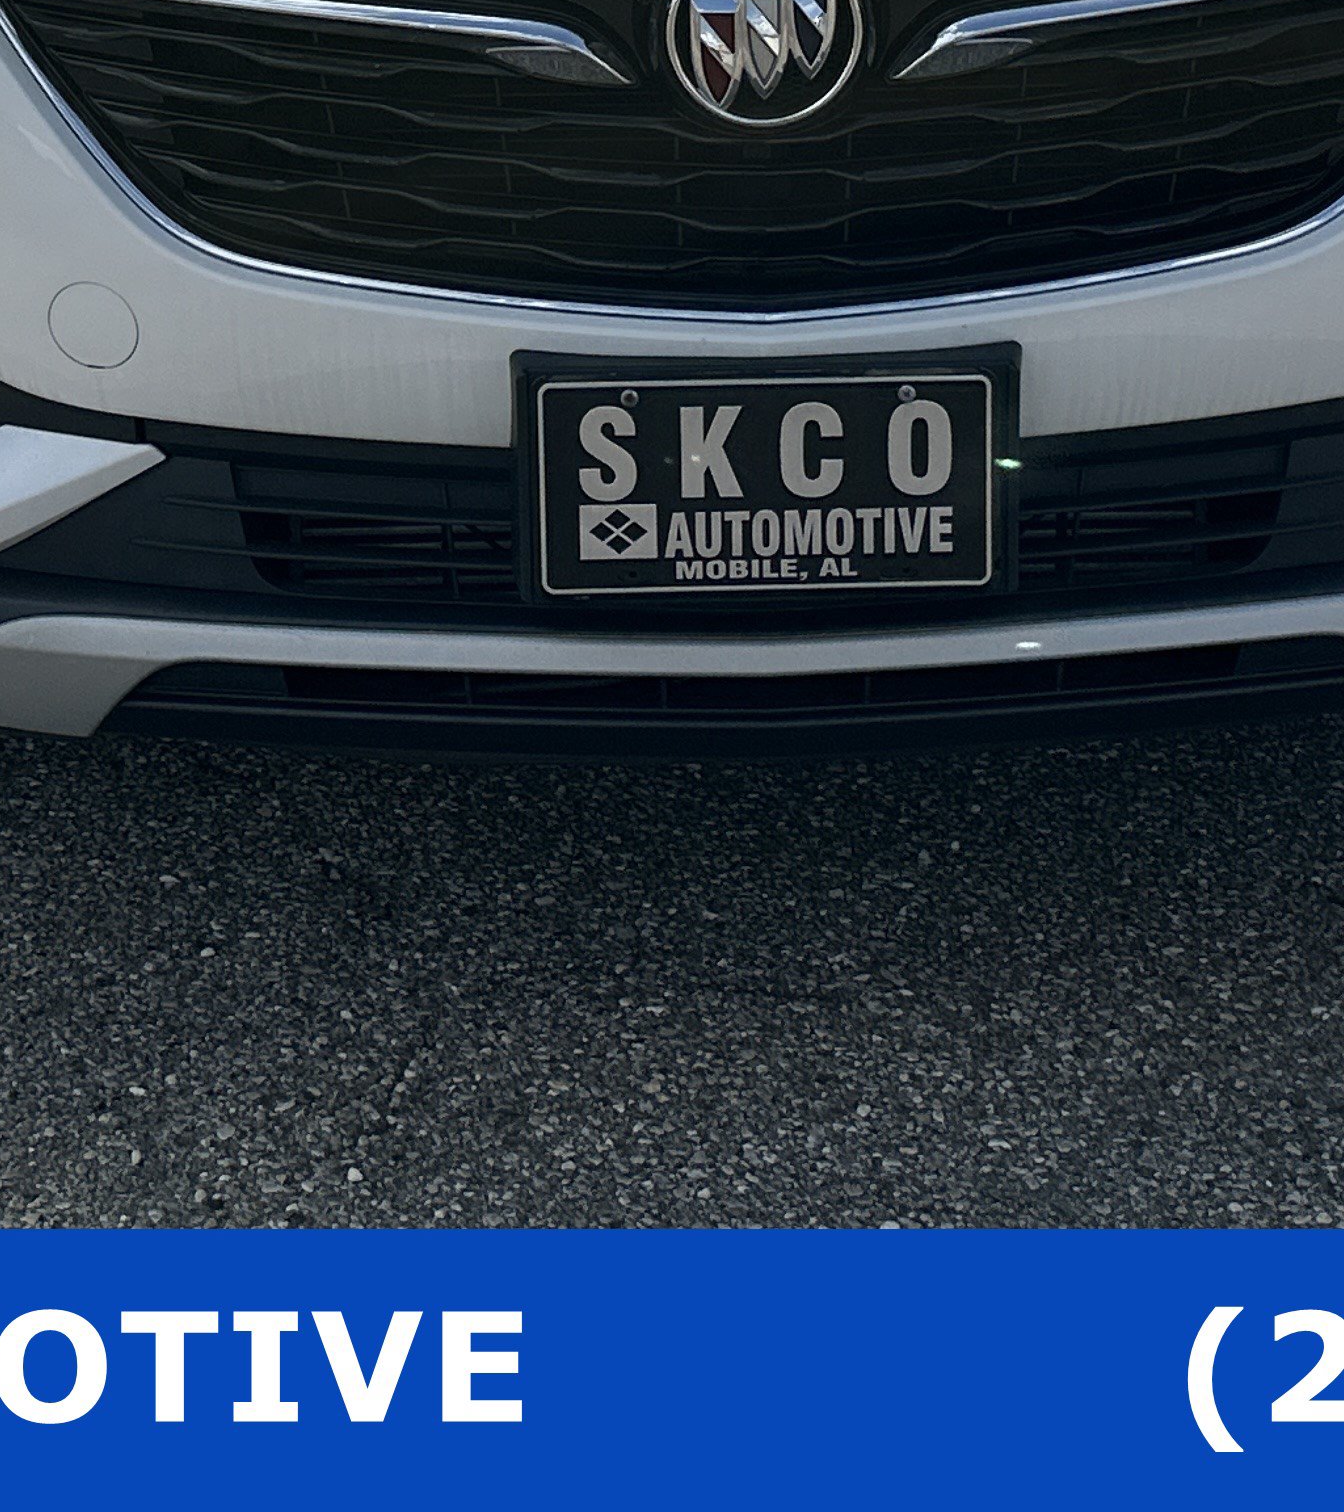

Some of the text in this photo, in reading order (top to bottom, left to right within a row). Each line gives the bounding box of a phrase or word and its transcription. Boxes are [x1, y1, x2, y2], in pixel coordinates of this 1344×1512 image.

[664, 506, 954, 560] AUTOMOTIVE
[675, 557, 858, 581] MOBILE, AL
